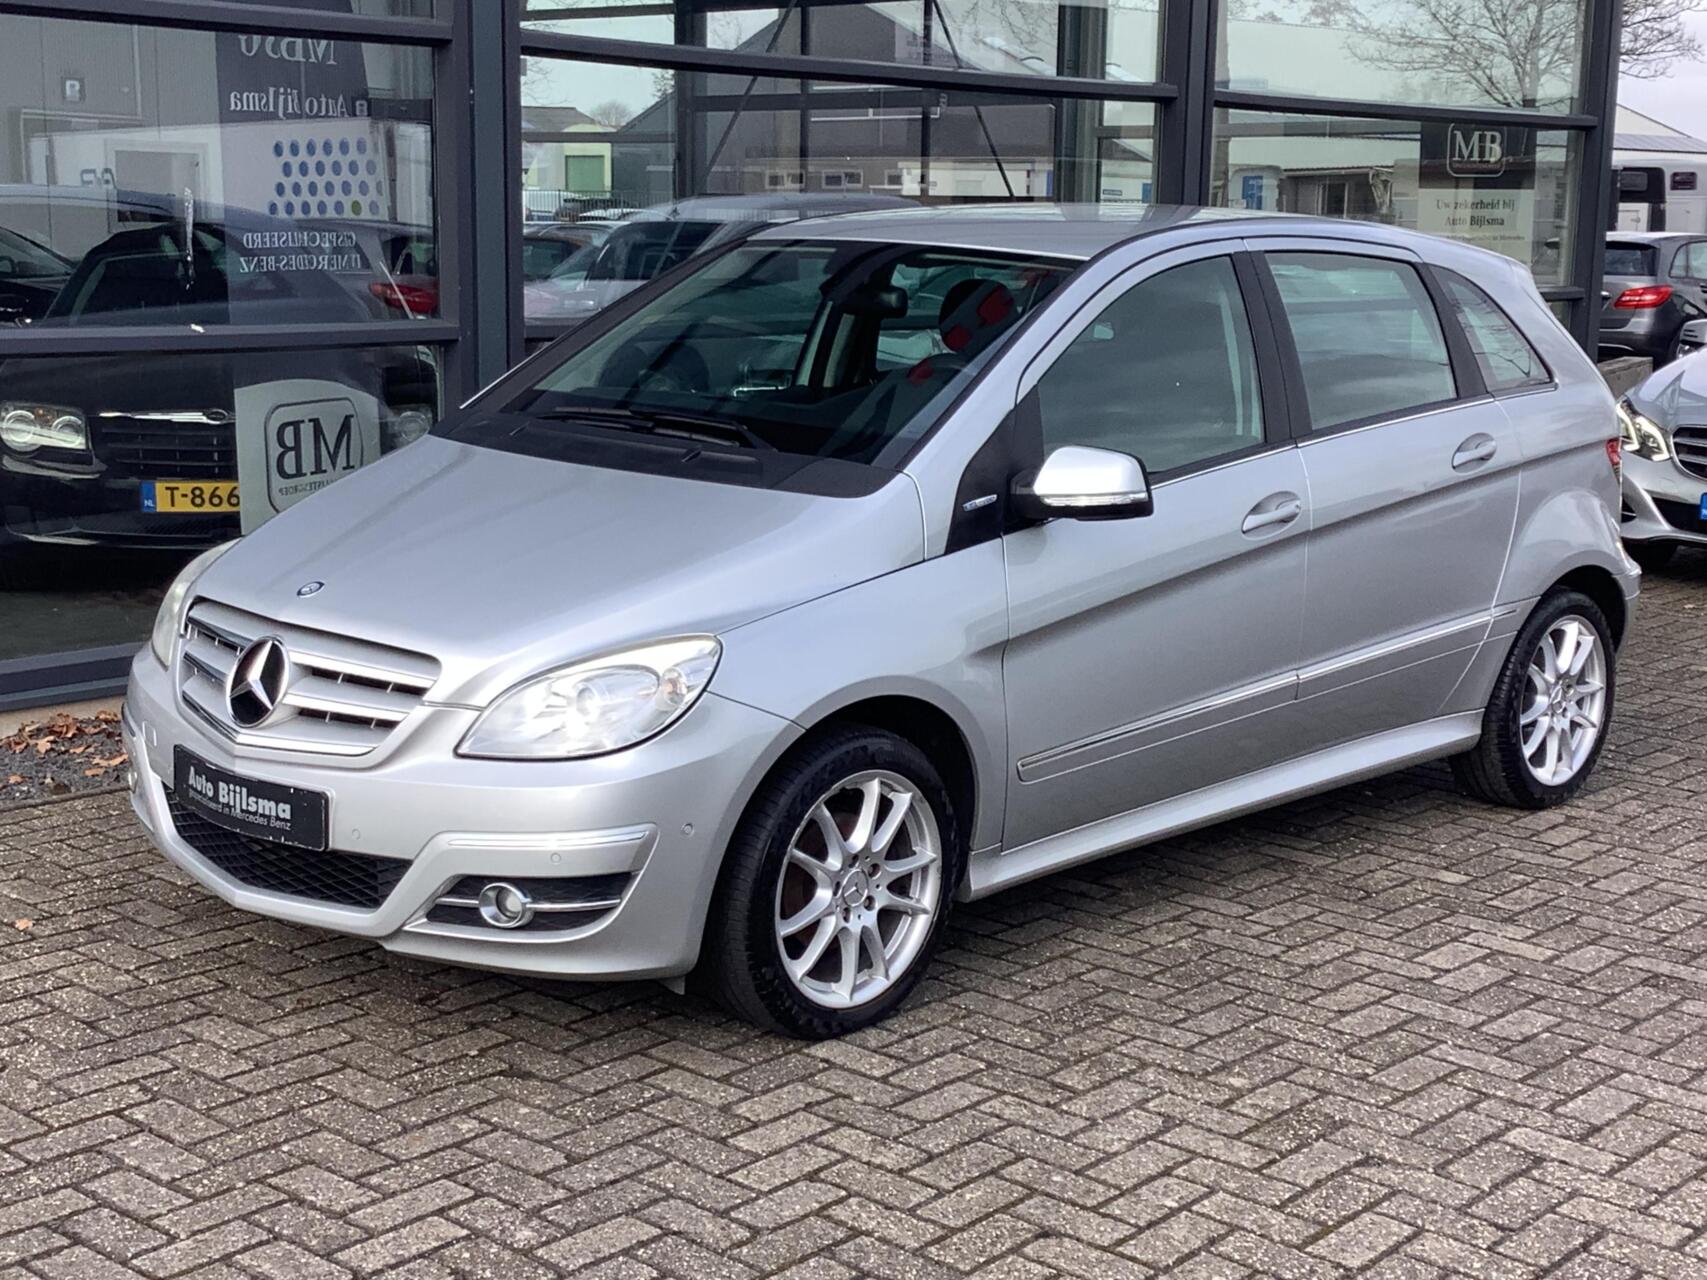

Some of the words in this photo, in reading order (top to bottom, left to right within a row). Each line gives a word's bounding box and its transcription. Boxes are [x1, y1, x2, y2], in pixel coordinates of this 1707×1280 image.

[1451, 130, 1503, 163] MB
[1454, 198, 1500, 210] zekerheid
[1445, 216, 1468, 226] Auto
[1469, 215, 1505, 228] Bijlsma
[144, 499, 154, 508] NL
[188, 766, 214, 798] Auto
[218, 781, 292, 820] Bijlsma
[231, 808, 268, 825] Mercedes
[270, 815, 292, 830] Benz
